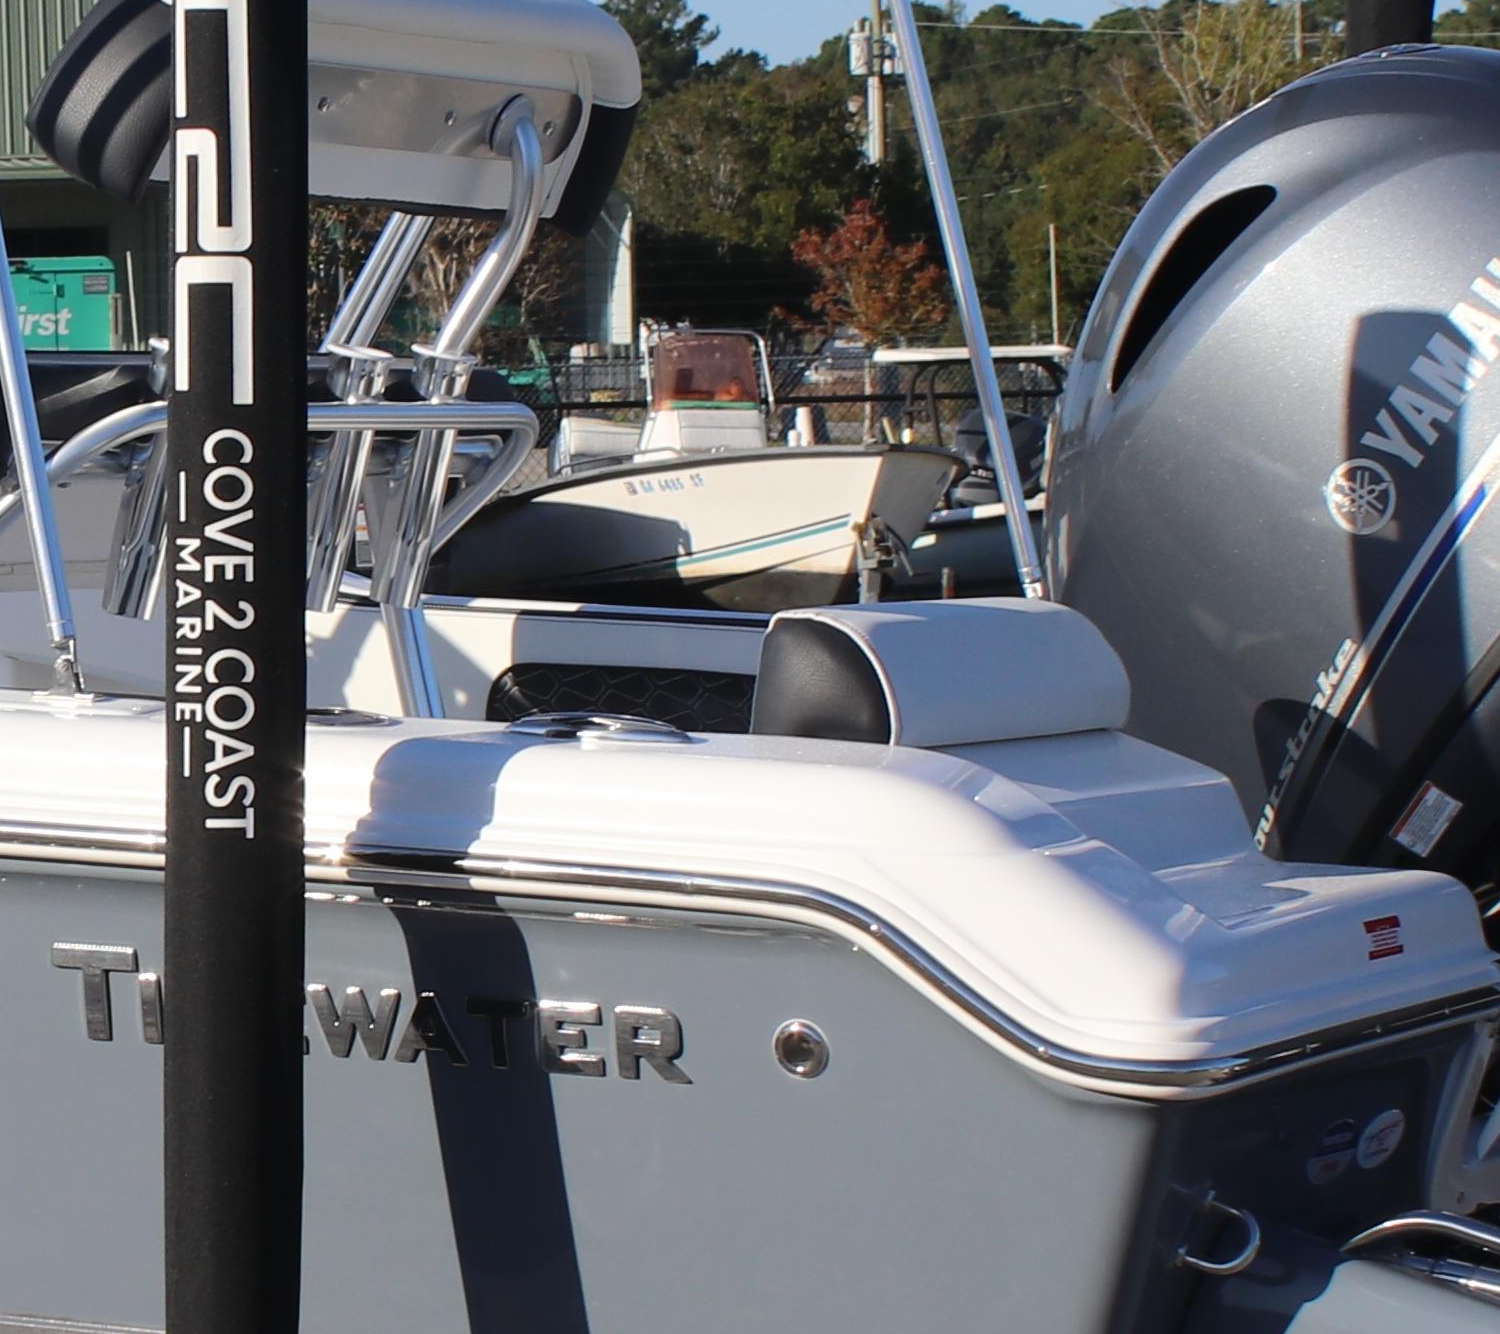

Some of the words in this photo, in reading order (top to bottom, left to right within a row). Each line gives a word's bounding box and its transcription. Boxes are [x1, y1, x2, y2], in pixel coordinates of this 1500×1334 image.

[203, 428, 254, 583] COVE
[175, 538, 202, 722] MARINE
[204, 600, 255, 631] 2
[204, 648, 255, 839] COAST
[1254, 784, 1278, 852] our
[51, 941, 693, 1084] TIWATER
